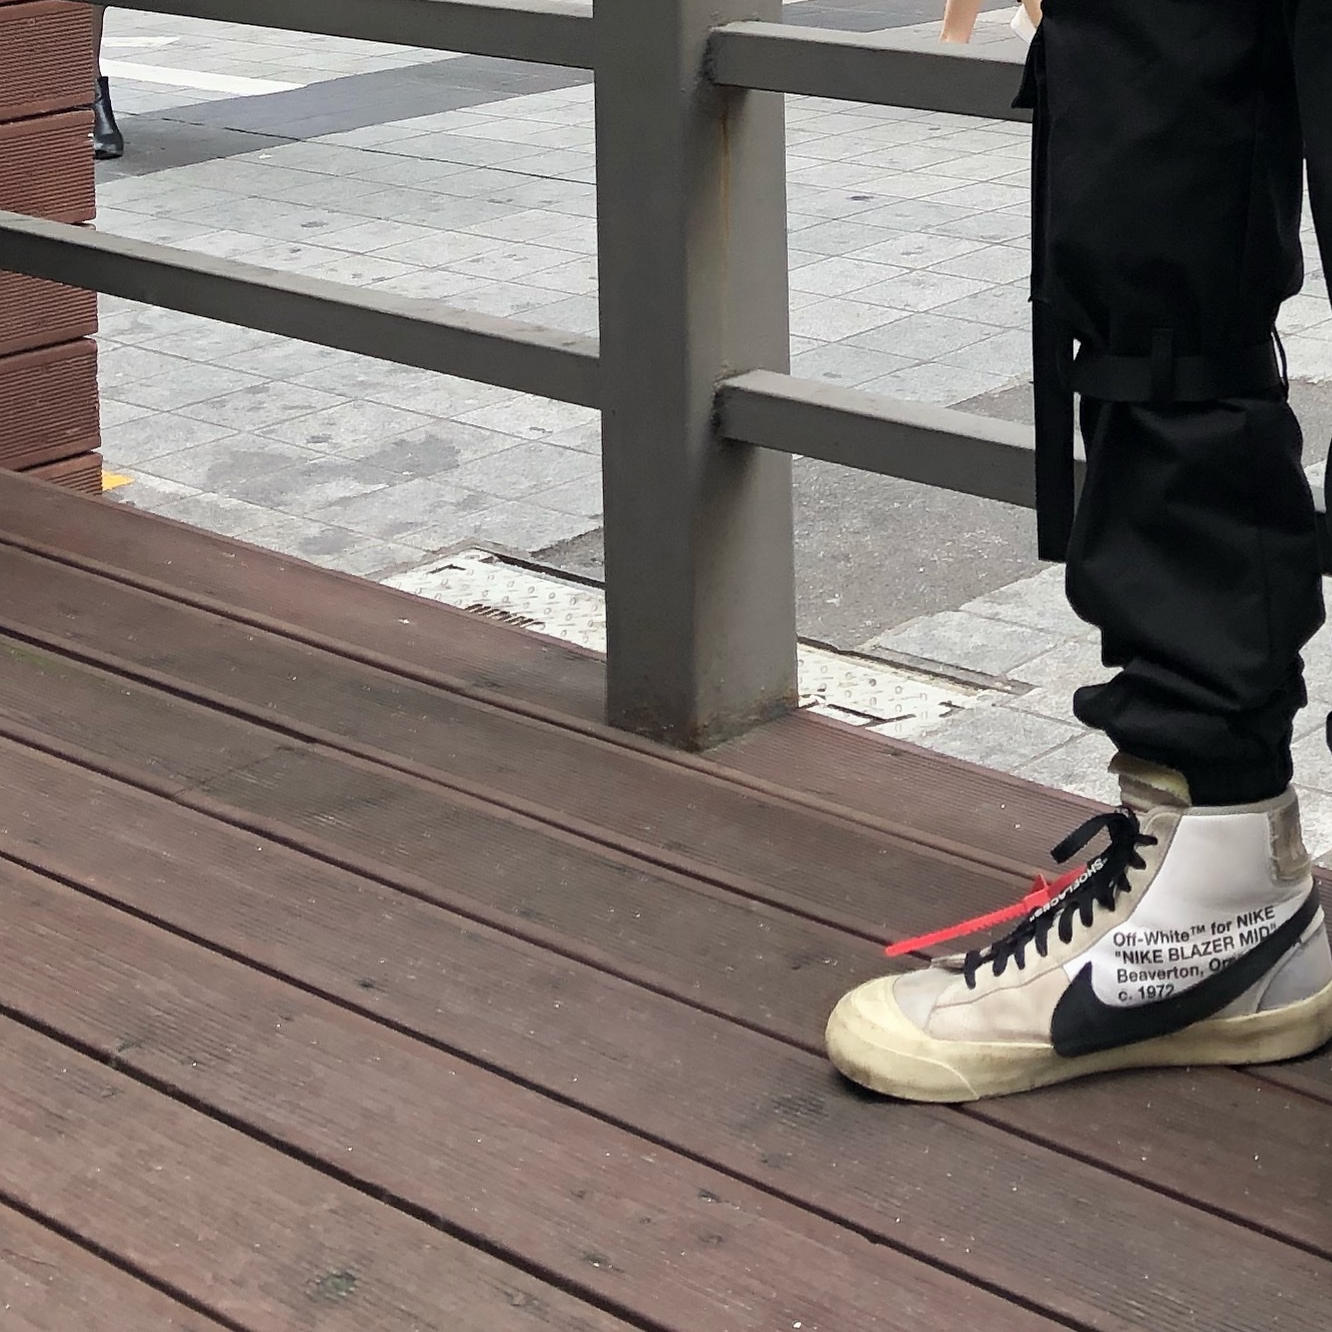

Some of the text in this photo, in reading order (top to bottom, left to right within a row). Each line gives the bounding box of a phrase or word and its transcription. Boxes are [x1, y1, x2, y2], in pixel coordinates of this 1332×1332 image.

[1211, 921, 1232, 936] for
[1236, 905, 1275, 929] NIKE
[1168, 936, 1235, 962] BLAZER
[1117, 967, 1204, 984] Beaverton,
[1118, 984, 1175, 1002] c. 1972
